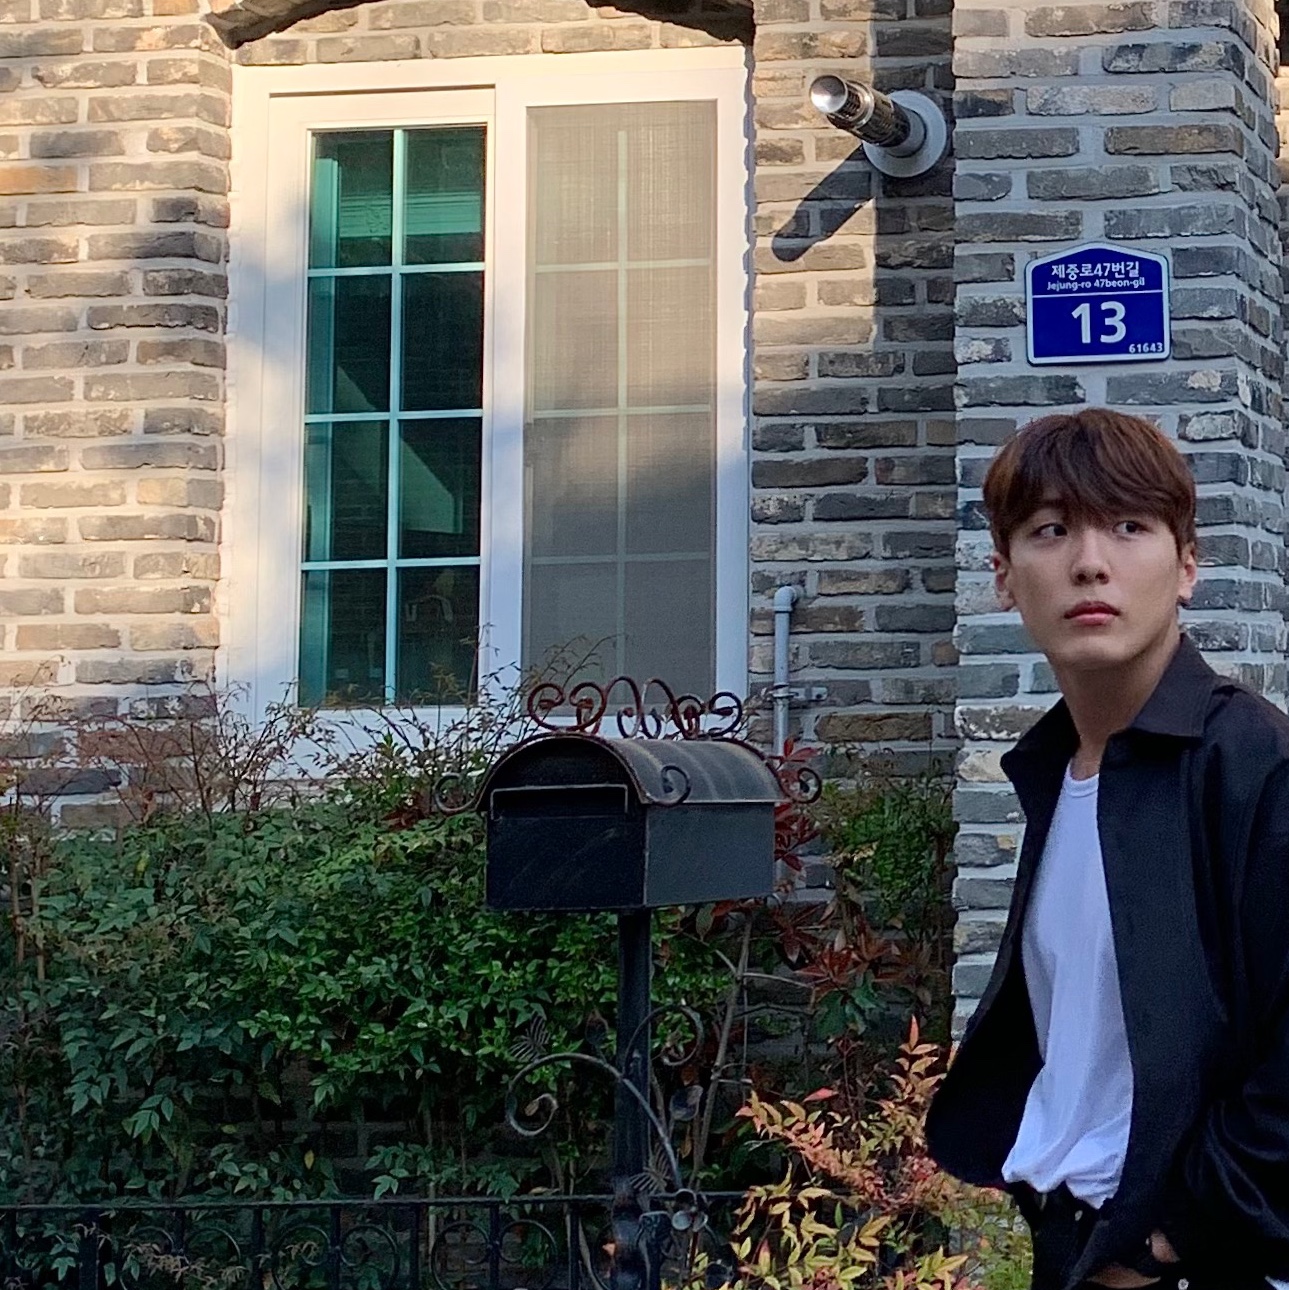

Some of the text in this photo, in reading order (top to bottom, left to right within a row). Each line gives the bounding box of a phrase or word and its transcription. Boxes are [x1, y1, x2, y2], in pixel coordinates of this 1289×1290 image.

[1051, 261, 1140, 281] 제중로47번길
[1047, 276, 1146, 292] Jejung-ro 47beon-gil
[1071, 300, 1127, 344] 13
[1128, 342, 1164, 354] 61643
